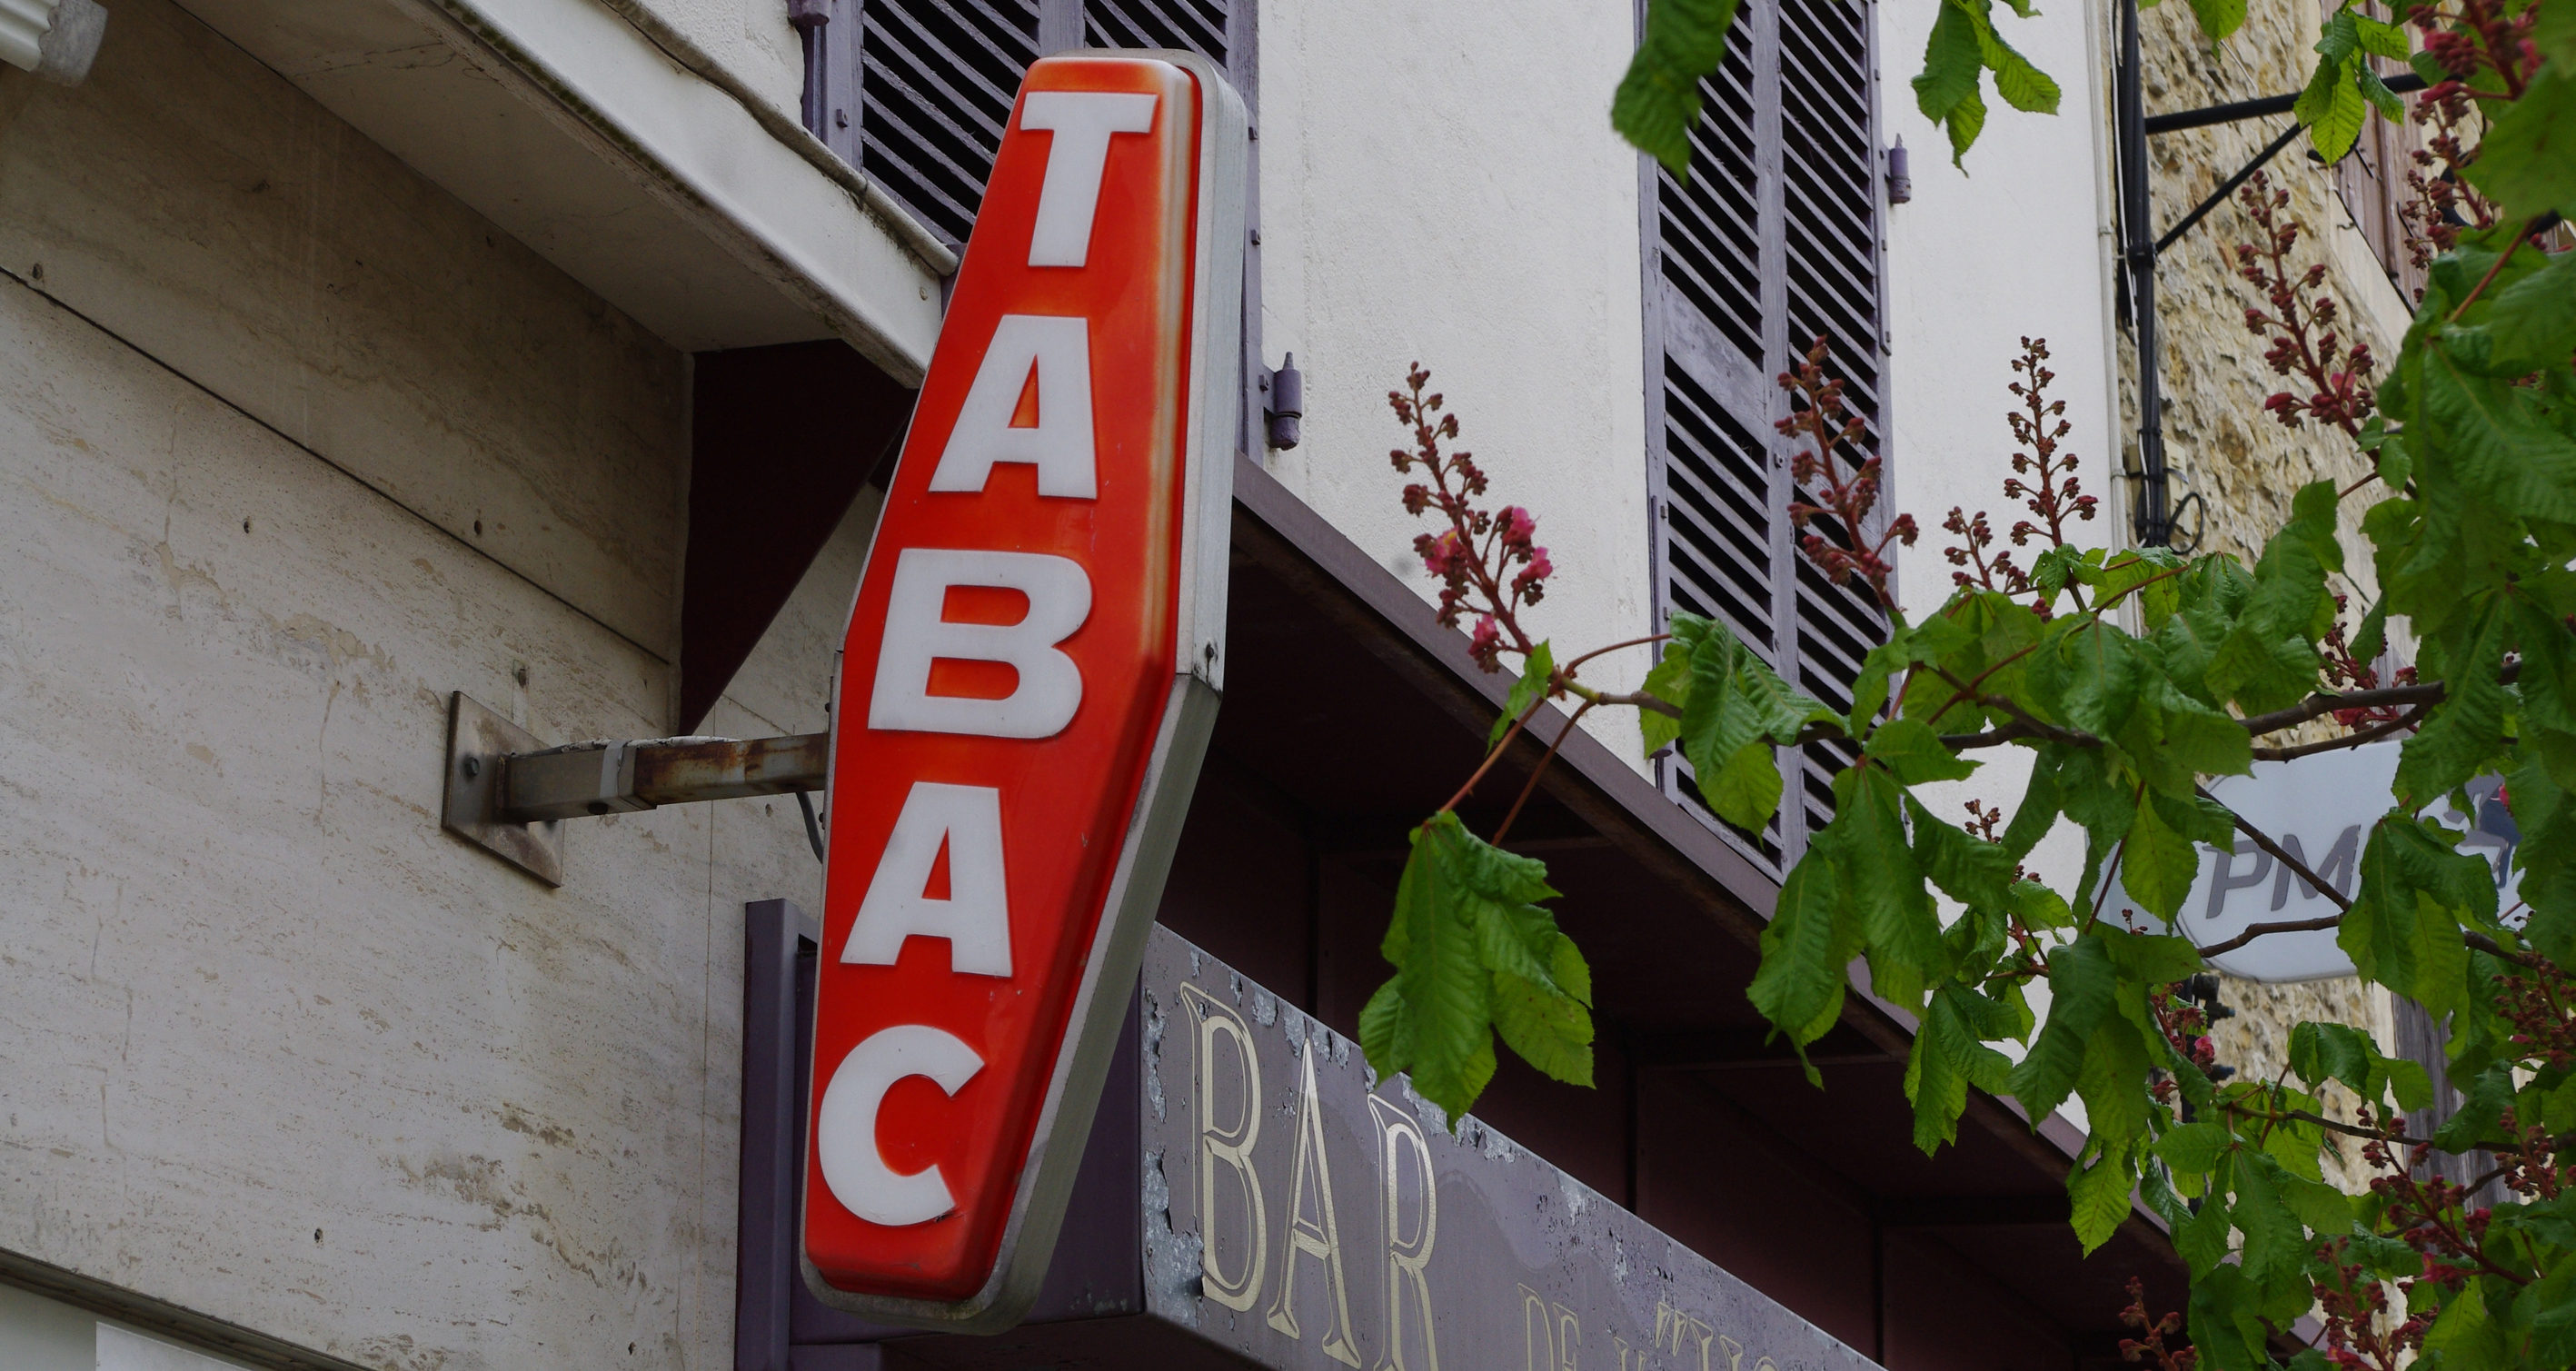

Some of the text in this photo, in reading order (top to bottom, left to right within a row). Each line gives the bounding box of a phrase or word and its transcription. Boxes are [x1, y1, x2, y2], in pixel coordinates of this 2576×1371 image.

[818, 91, 1159, 1227] TABAC
[2202, 823, 2379, 919] PM
[1180, 981, 1440, 1371] BAR
